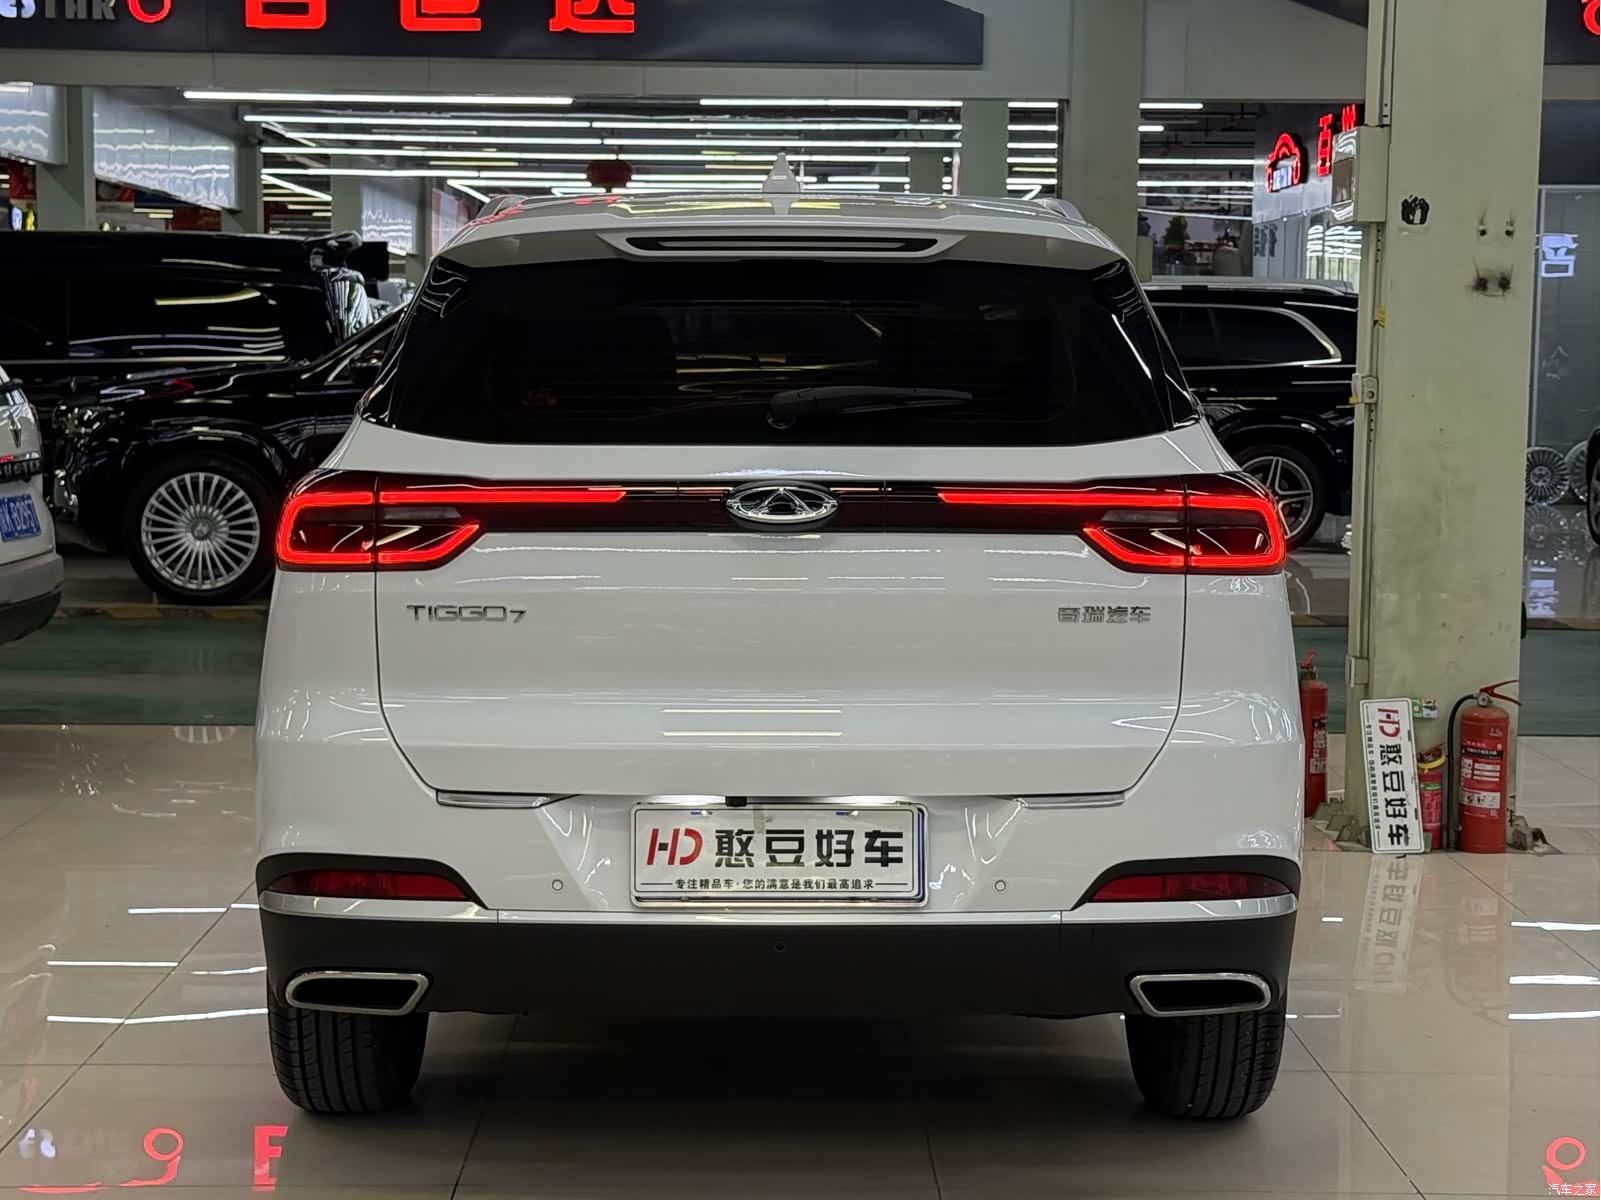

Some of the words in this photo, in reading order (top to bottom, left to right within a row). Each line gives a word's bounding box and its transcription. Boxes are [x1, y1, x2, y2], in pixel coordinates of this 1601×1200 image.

[1057, 605, 1151, 624] 奇瑞汽车
[1380, 743, 1409, 846] 憨豆好车
[715, 829, 904, 868] 憨豆好车
